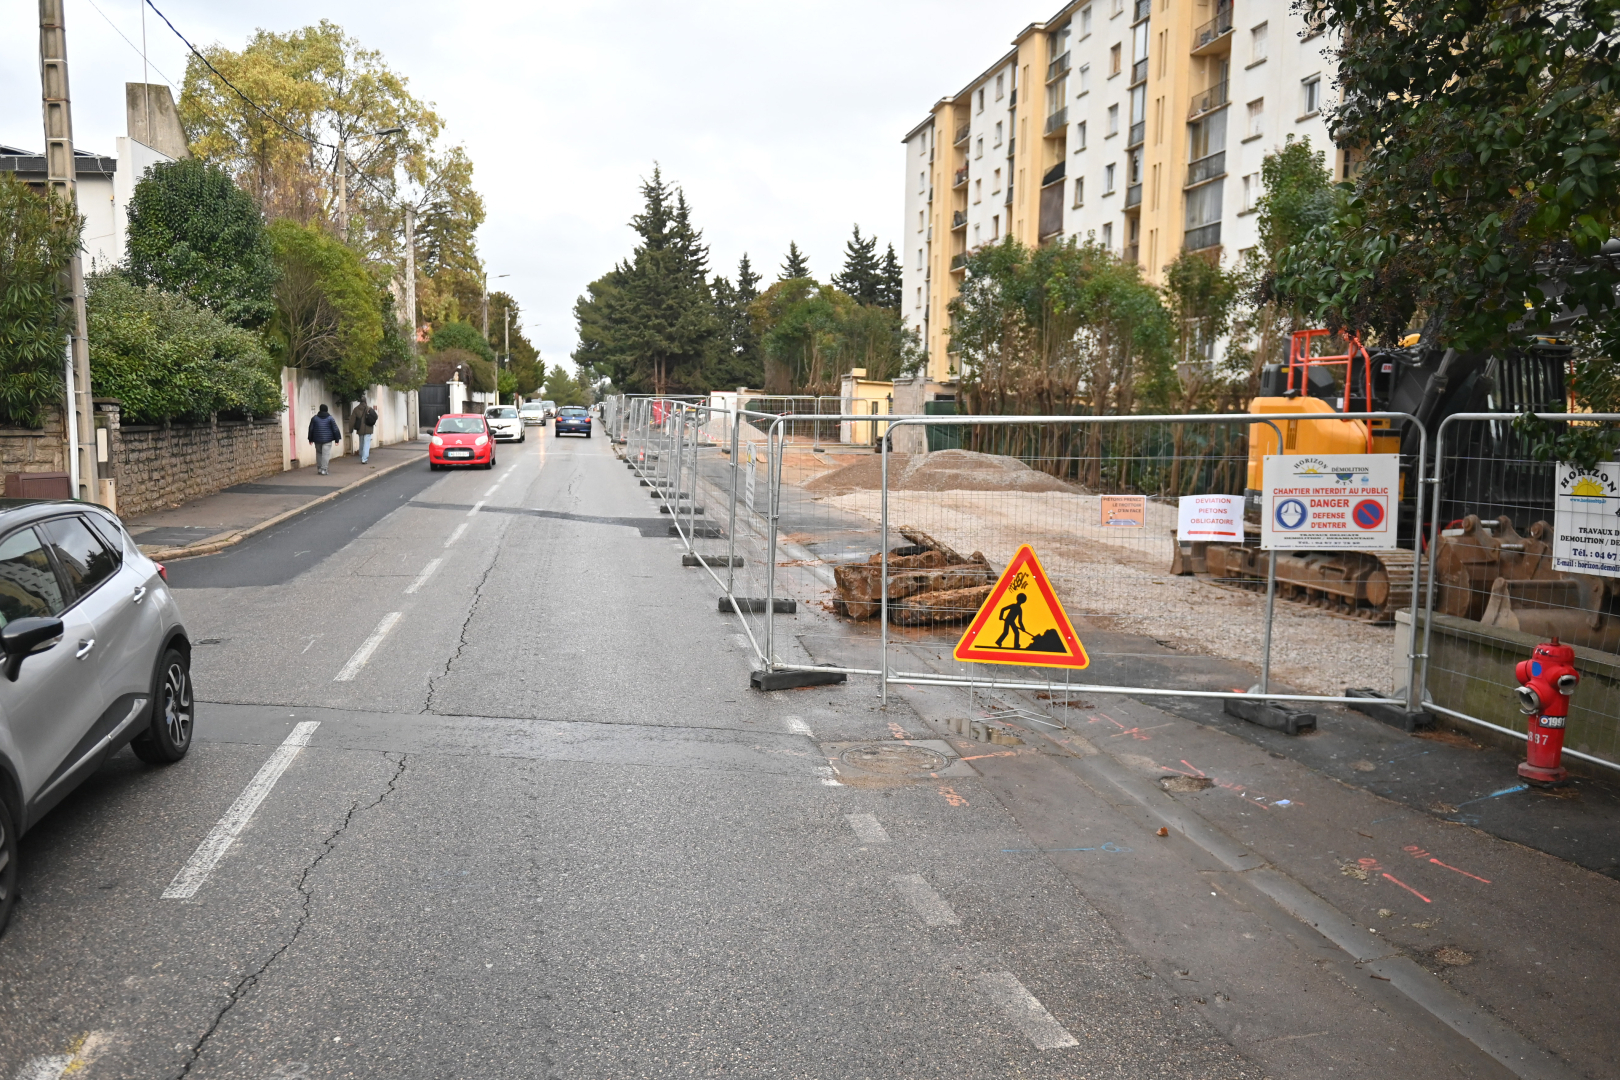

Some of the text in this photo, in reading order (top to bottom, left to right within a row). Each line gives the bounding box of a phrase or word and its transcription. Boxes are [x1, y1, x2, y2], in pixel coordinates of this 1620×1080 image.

[1294, 458, 1328, 470] HORIZON
[1560, 468, 1616, 492] HORIZON
[1310, 499, 1350, 508] DANGER
[1579, 527, 1613, 536] TRAVAUX
[1560, 535, 1604, 544] DEMOLITION
[1572, 548, 1588, 557] Tél.
[1607, 552, 1617, 560] 67
[1557, 559, 1574, 567] E-mail
[1548, 716, 1565, 726] 1991
